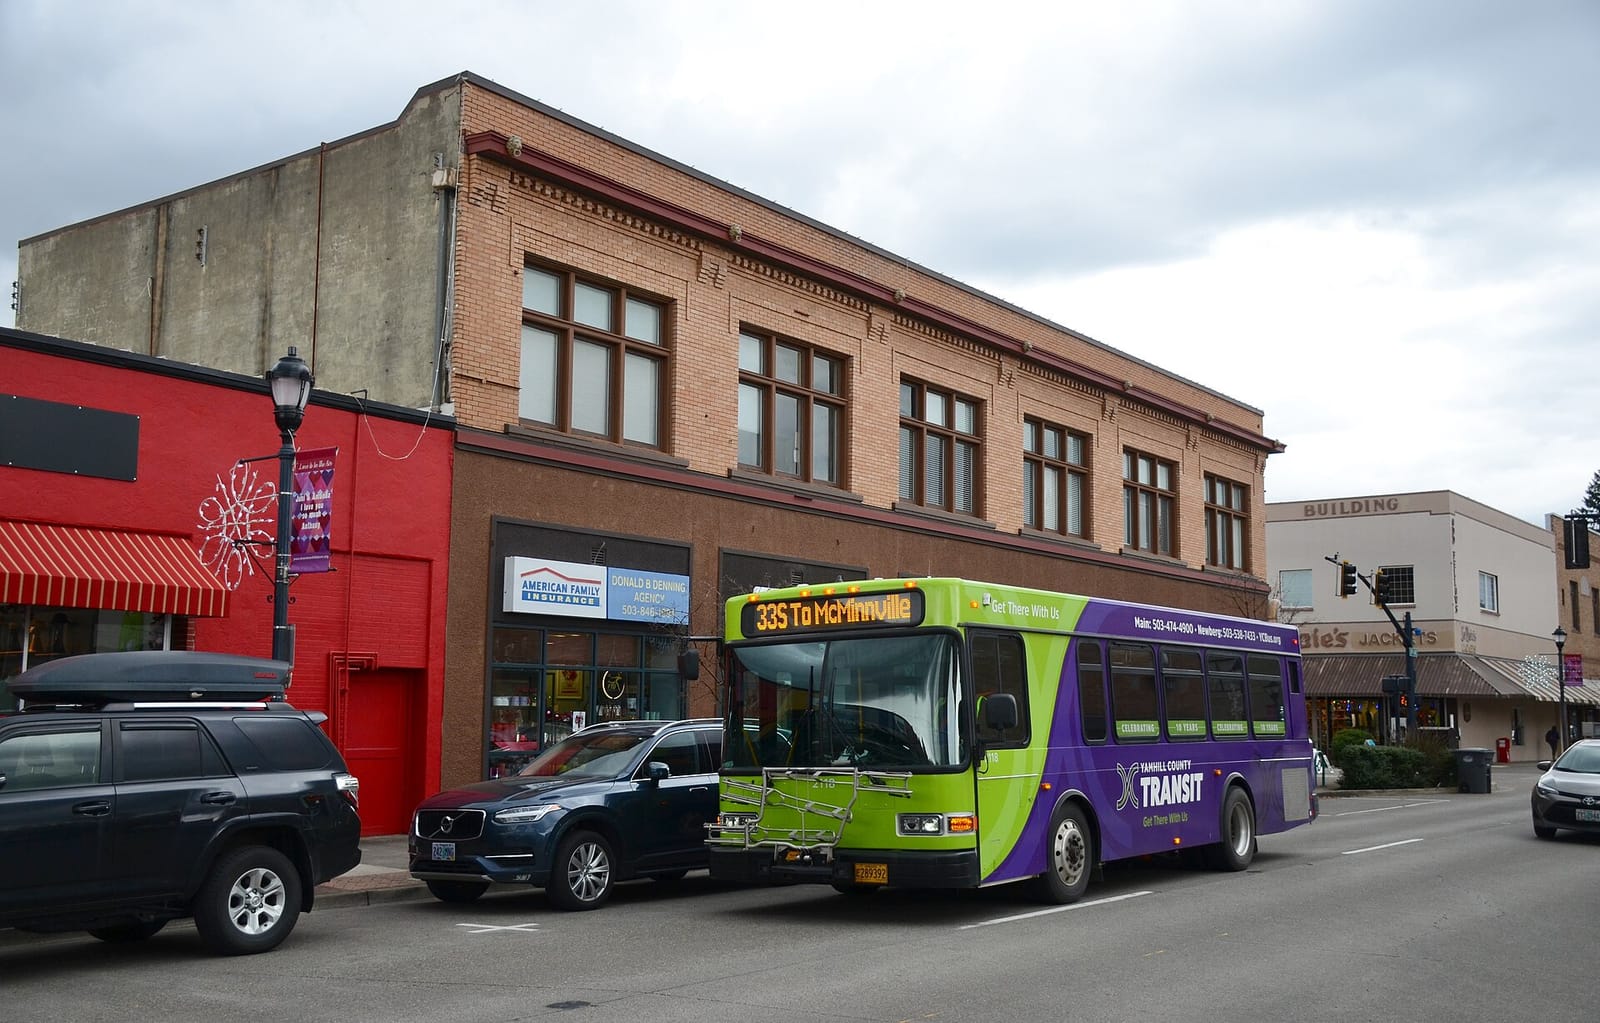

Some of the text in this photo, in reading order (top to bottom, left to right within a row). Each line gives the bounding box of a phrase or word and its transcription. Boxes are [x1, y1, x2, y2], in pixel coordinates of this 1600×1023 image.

[1303, 497, 1399, 517] BUILDING
[522, 580, 600, 596] AMERICAN FAMILY
[611, 575, 686, 593] DONALD B DENNING
[527, 592, 595, 605] INSURANCE
[633, 592, 665, 604] AGENCY
[756, 594, 911, 631] 33S To McMinnville
[991, 599, 1060, 619] Get There With Us
[1134, 616, 1152, 630] Main:
[1152, 619, 1194, 634] 503-474-4900
[1197, 624, 1222, 638] Newberg:
[1258, 632, 1281, 645] YCBus.org
[1358, 631, 1438, 646] JACKTS
[1121, 723, 1155, 733] CELEBRATING
[1175, 723, 1199, 732] 10 YEARS
[1140, 759, 1192, 774] YAMHILL COUNTY
[812, 778, 836, 789] 2118
[1140, 772, 1204, 808] TRANSIT
[1143, 811, 1189, 828] Get There With Us
